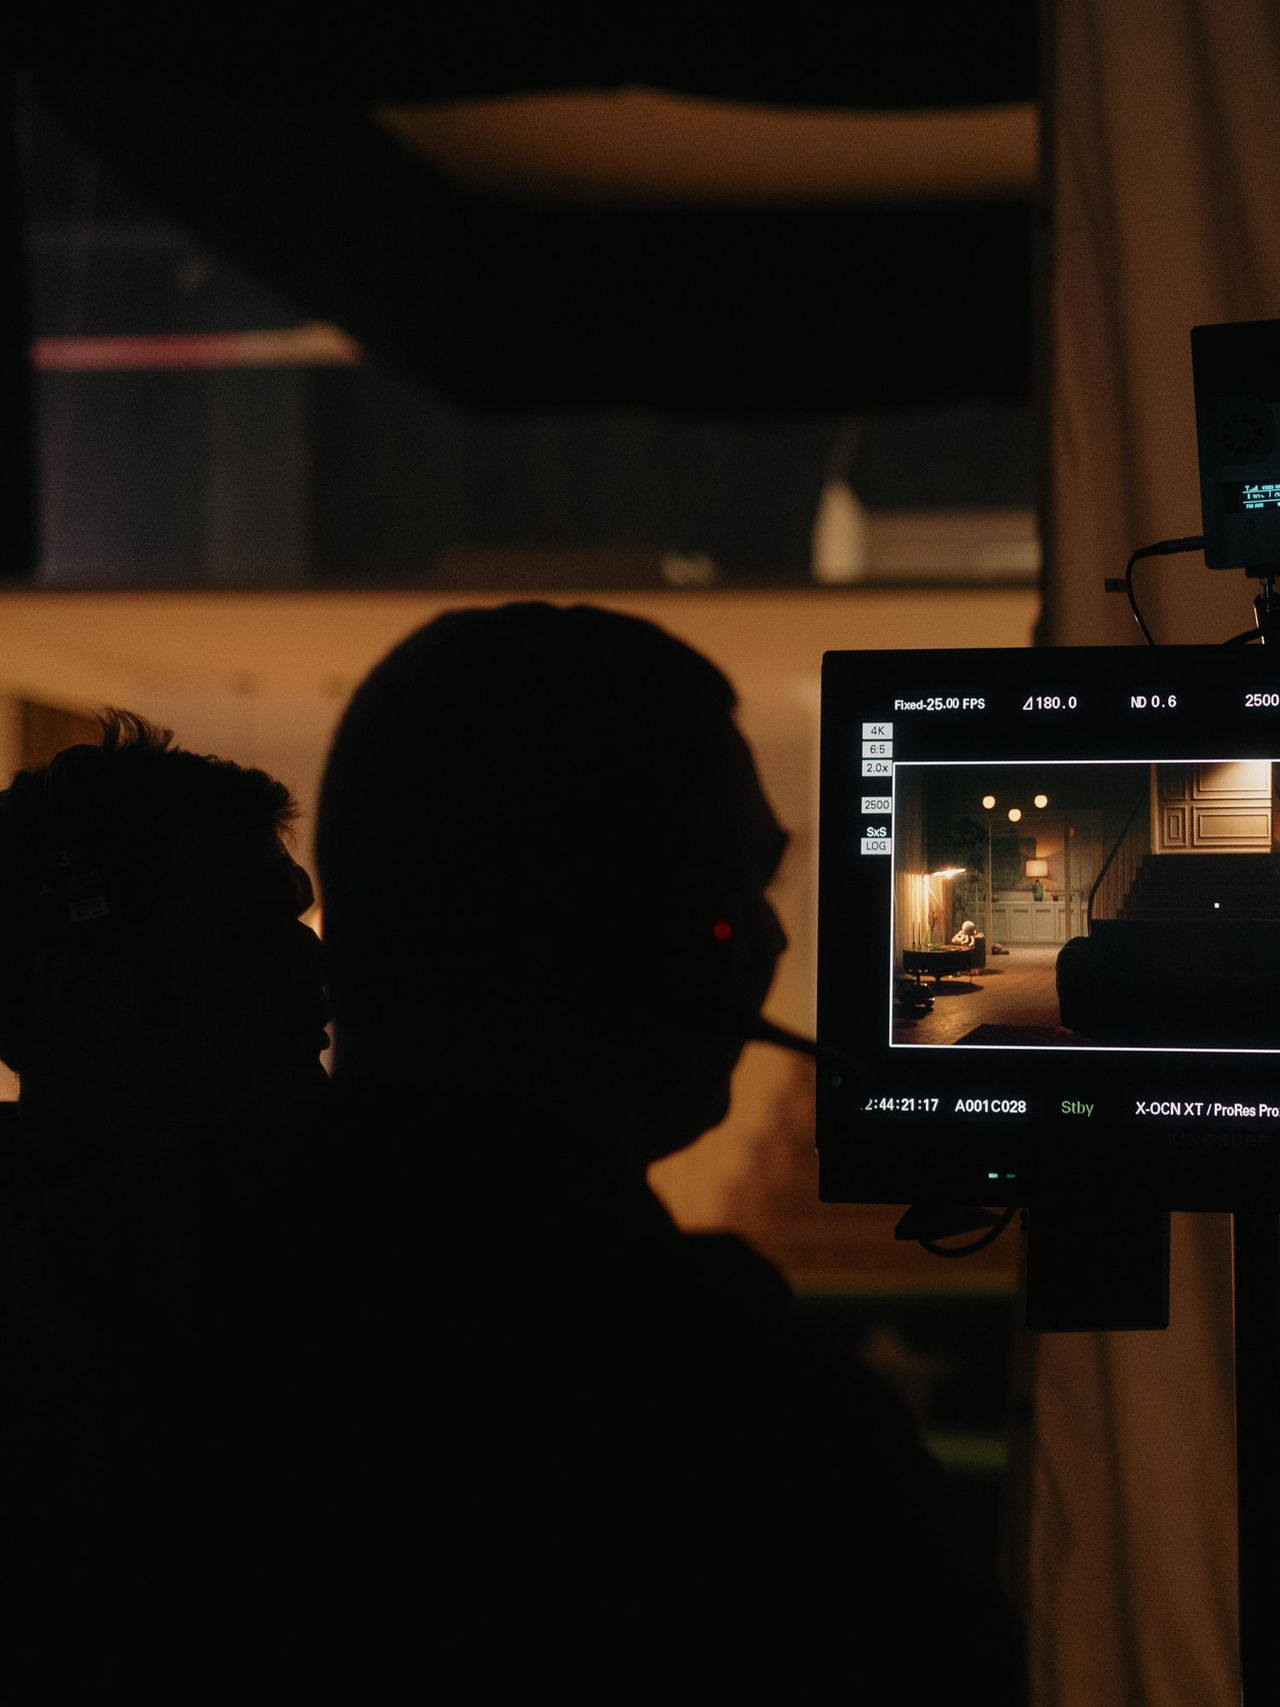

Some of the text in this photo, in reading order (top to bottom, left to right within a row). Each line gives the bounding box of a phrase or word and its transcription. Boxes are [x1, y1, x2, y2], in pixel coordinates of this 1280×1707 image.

[962, 697, 986, 710] FPS
[1130, 694, 1177, 709] ND 0.6
[870, 725, 885, 736] 4K
[866, 763, 889, 773] 2.0x
[864, 799, 890, 810] 2500
[866, 826, 887, 837] SxS
[866, 840, 886, 851] LOG
[860, 1097, 939, 1112] 2:44:21:17
[954, 1098, 1027, 1113] A001C028
[1061, 1100, 1095, 1118] Stby
[1135, 1101, 1181, 1116] X-OCN
[1183, 1102, 1204, 1116] XT
[1213, 1102, 1257, 1118] ProRes
